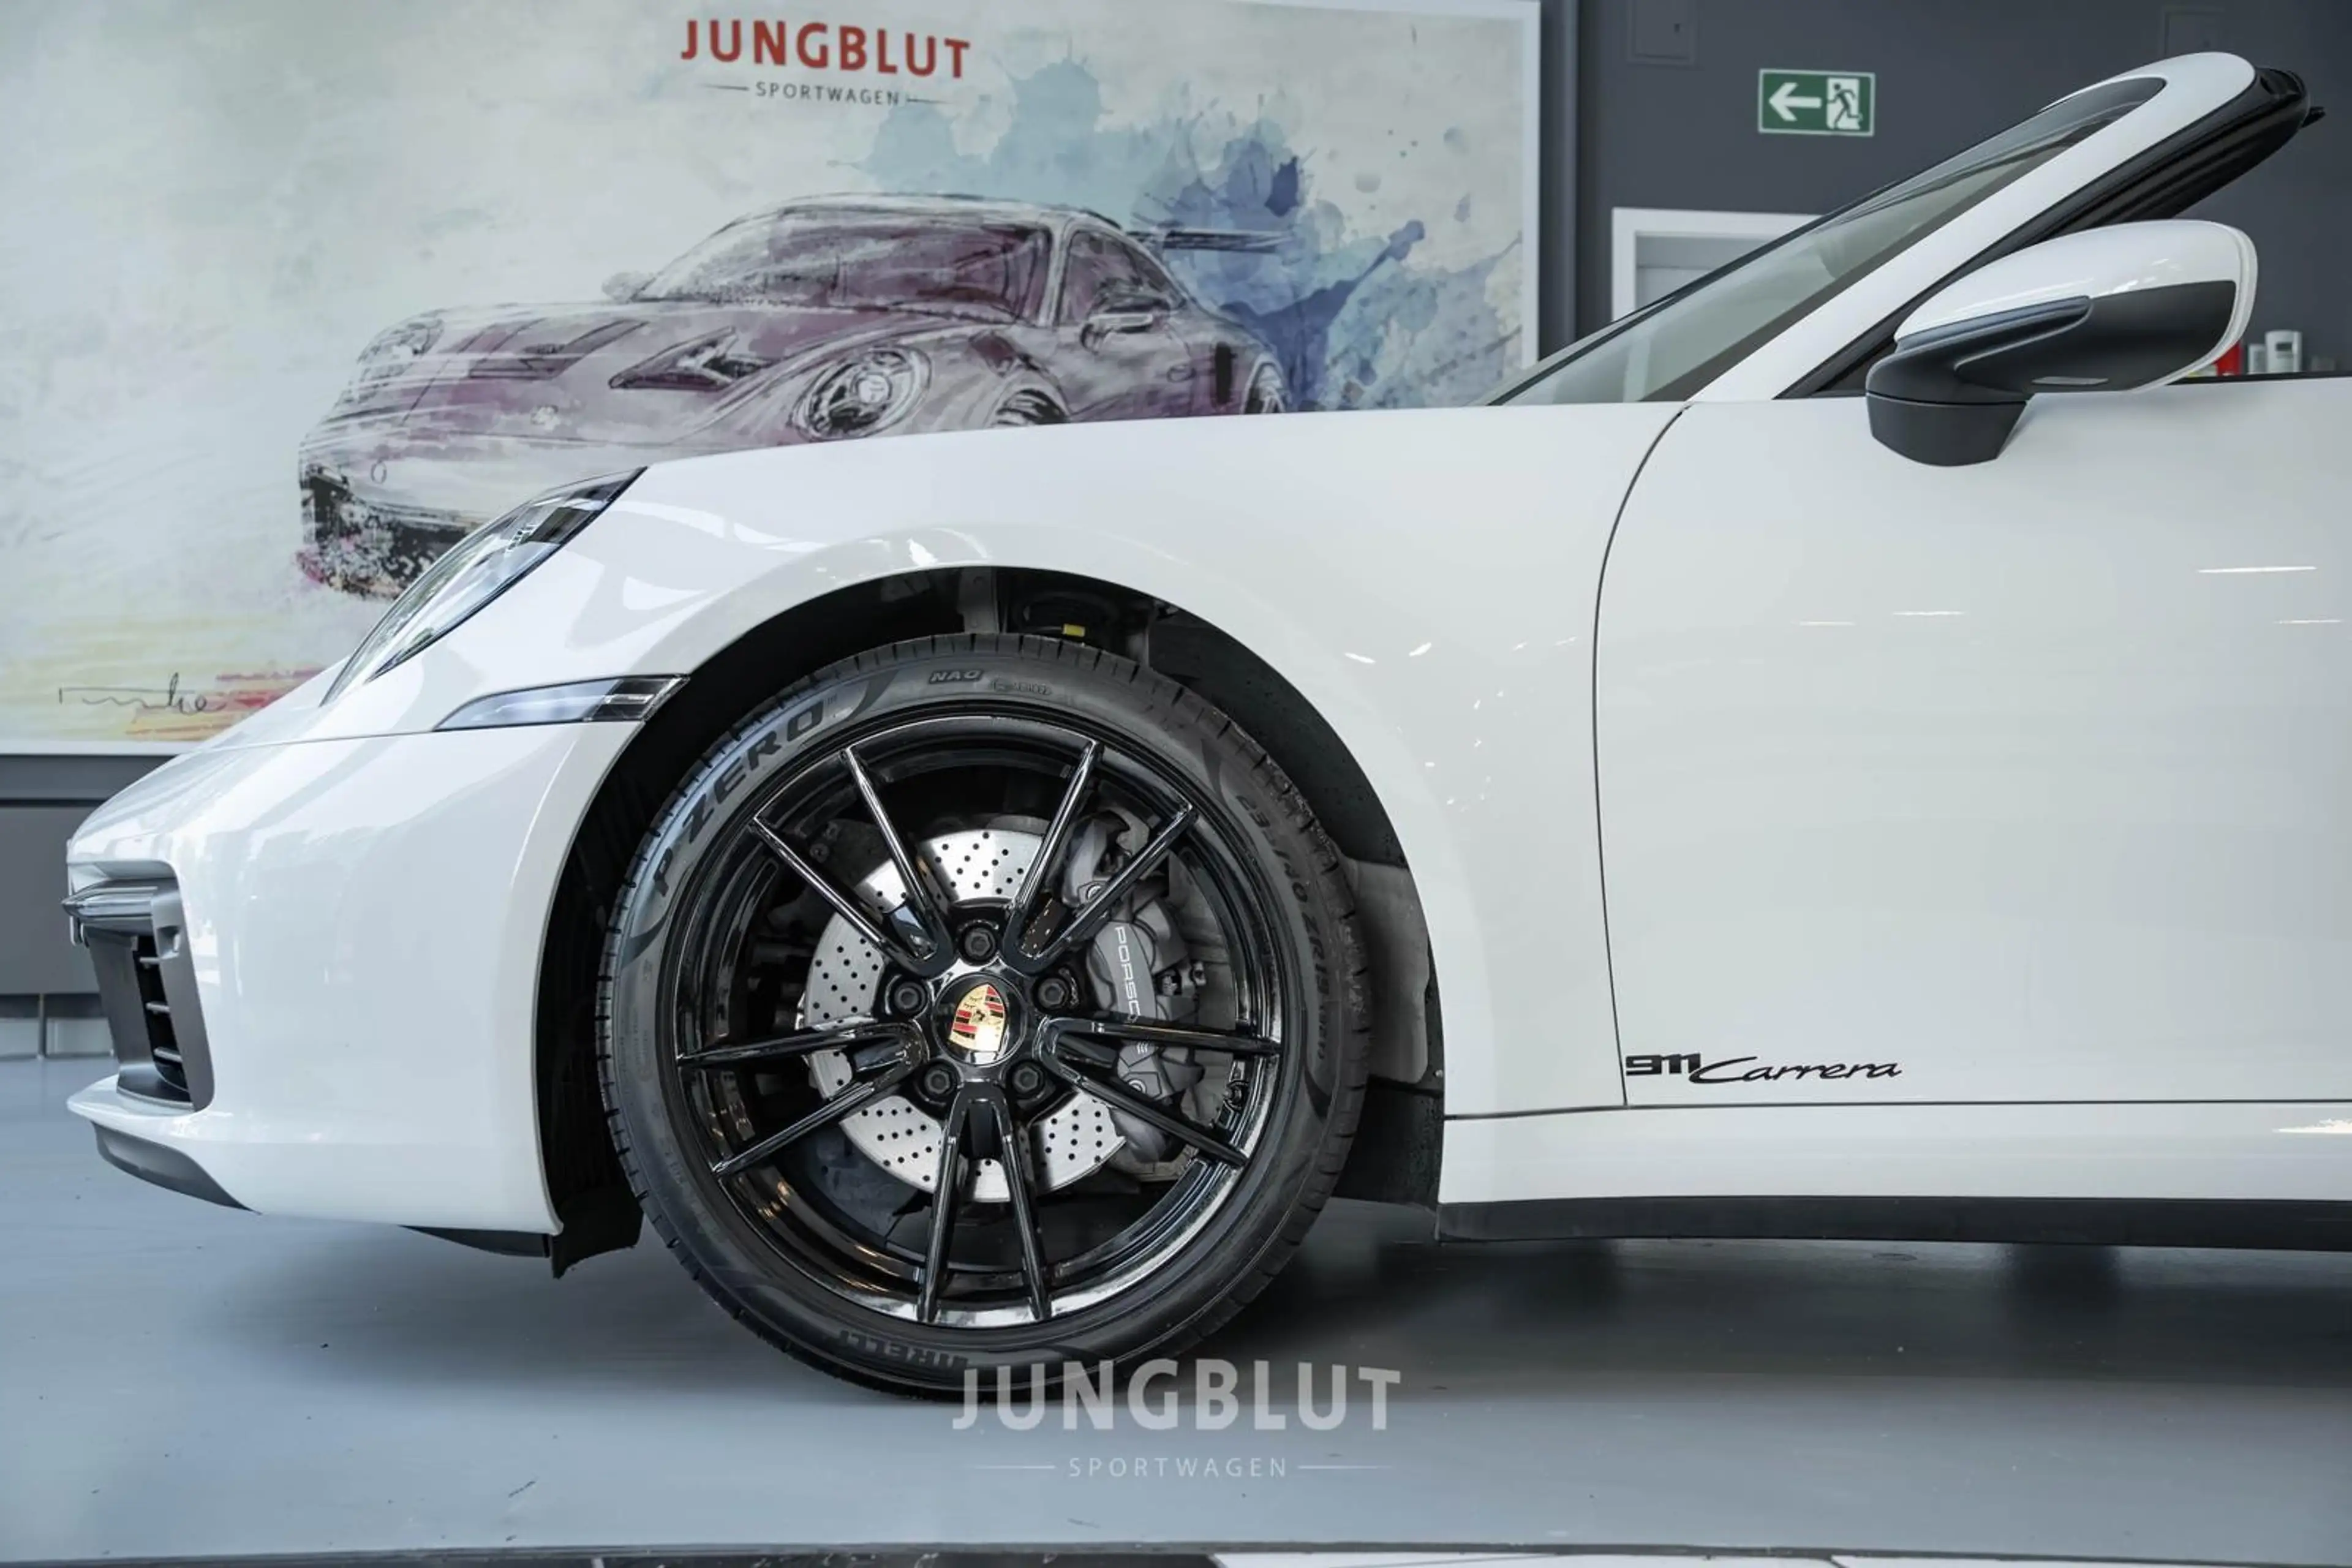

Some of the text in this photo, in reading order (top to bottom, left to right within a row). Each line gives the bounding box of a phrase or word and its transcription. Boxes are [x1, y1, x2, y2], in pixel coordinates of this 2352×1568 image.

[681, 20, 970, 78] JUNGBLUT
[755, 81, 900, 105] SPORTWAGEN
[654, 699, 826, 897] P ZERO
[1626, 1053, 1902, 1084] 911 Carrera
